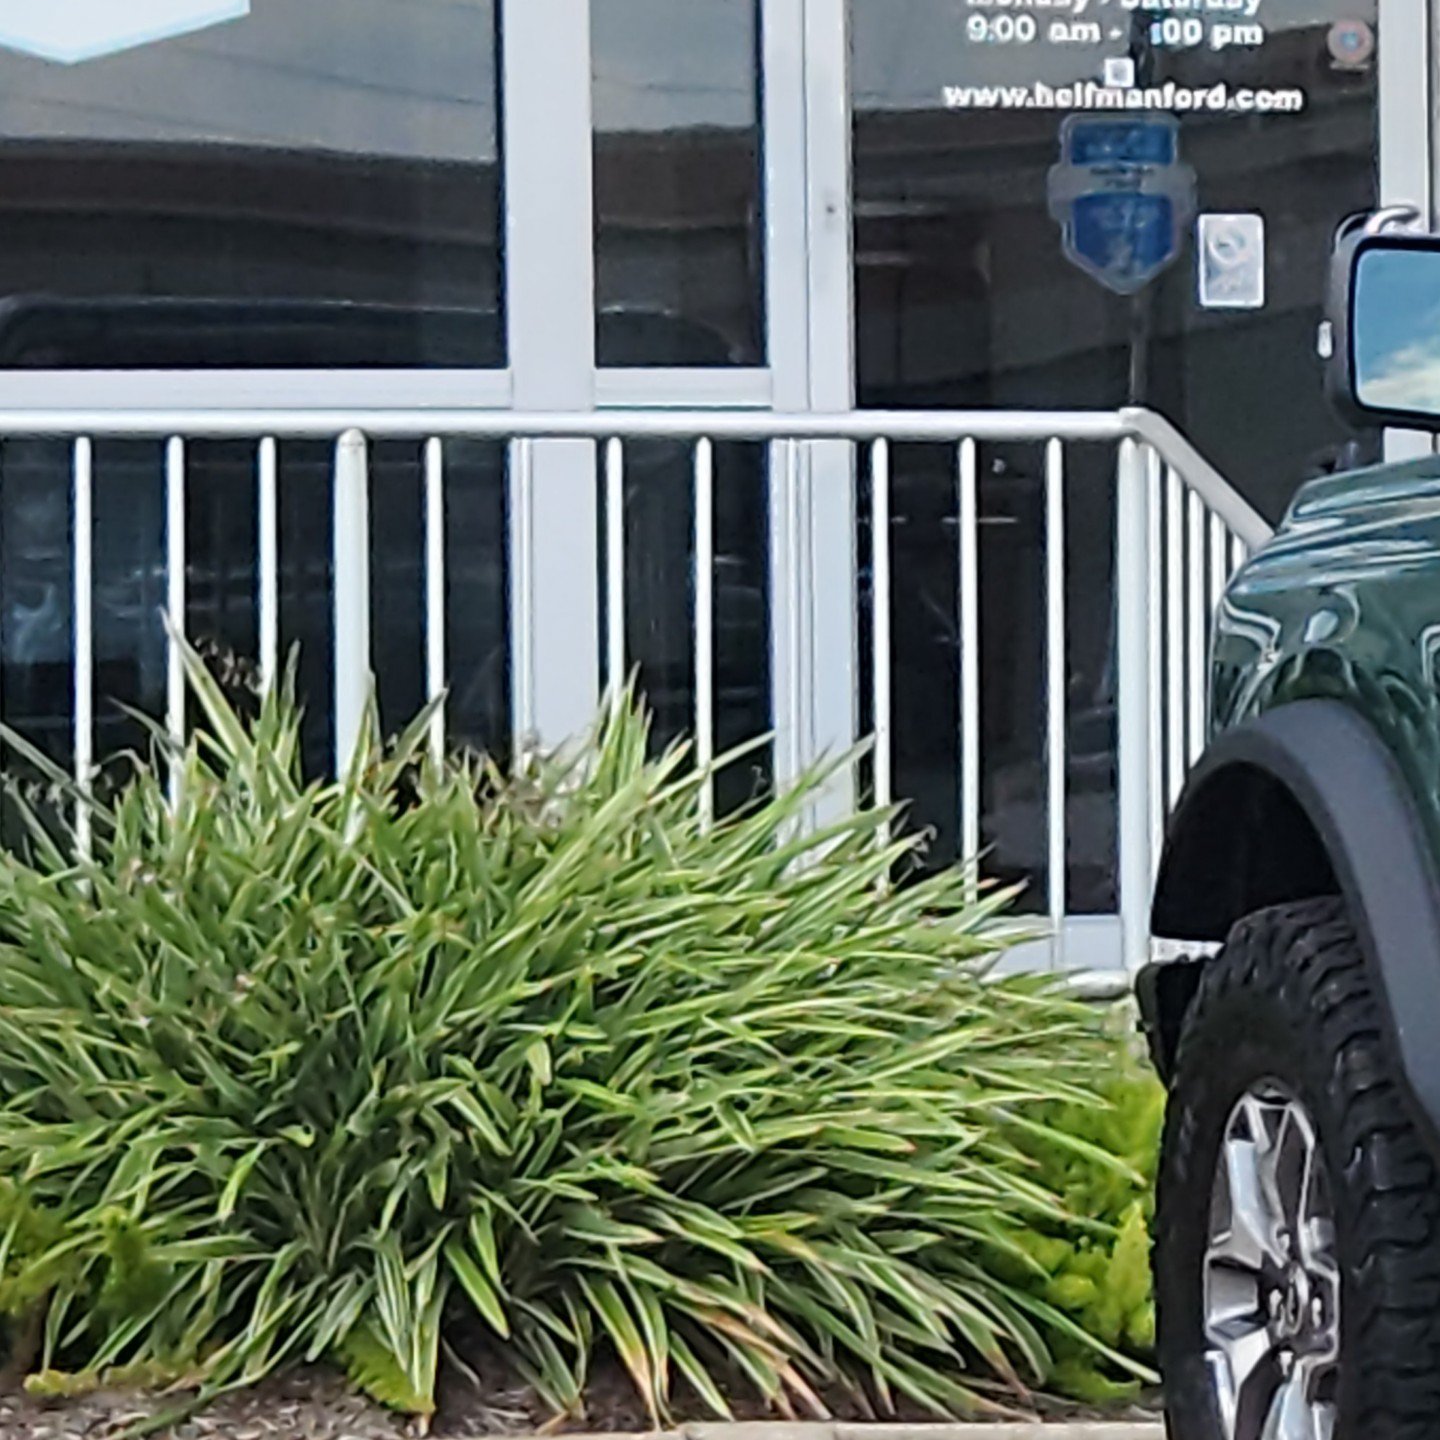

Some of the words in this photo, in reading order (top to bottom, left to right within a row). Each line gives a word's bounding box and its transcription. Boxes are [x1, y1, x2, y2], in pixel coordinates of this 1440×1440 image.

[966, 14, 1036, 41] 9:00
[1048, 20, 1101, 42] am
[1210, 21, 1264, 49] pm
[943, 81, 1303, 109] www.helfmanford.com
